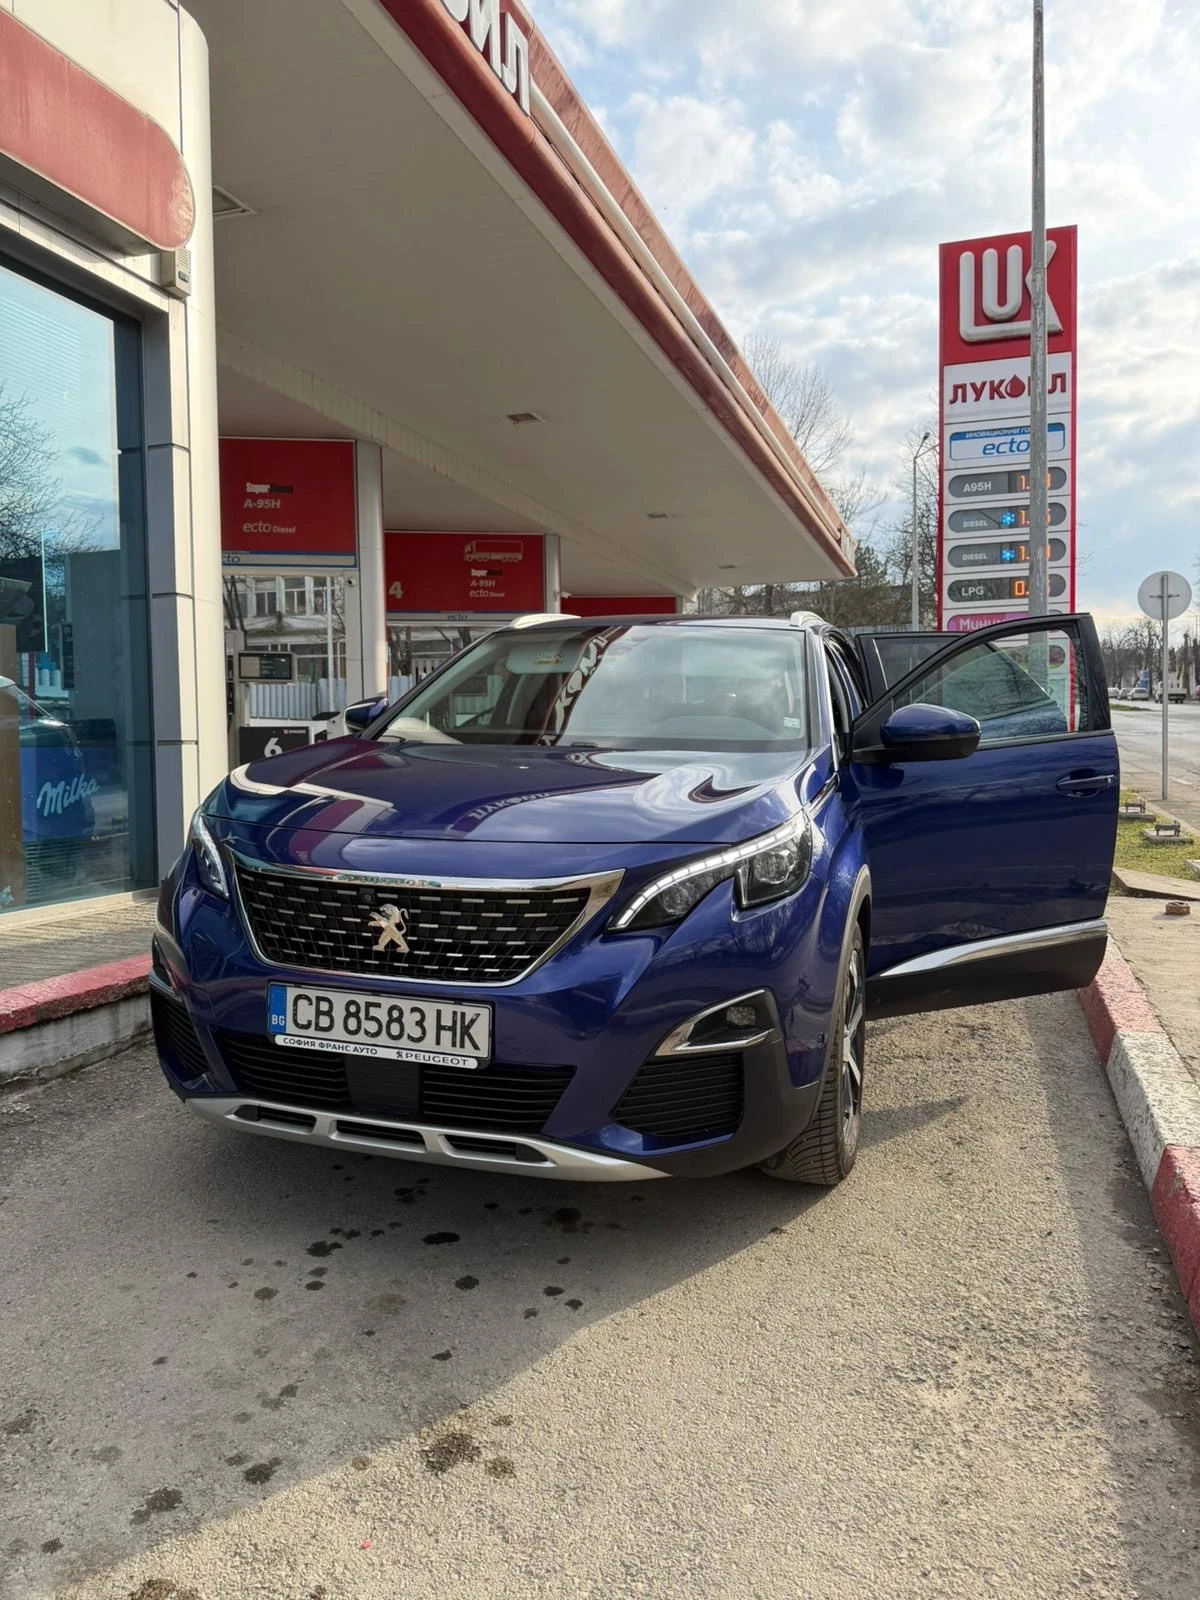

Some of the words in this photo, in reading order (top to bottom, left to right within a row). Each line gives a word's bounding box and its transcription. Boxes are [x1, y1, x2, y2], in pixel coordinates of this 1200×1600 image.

[982, 437, 1030, 456] ecto
[963, 481, 992, 493] A95H
[243, 498, 281, 509] A-95H
[242, 520, 271, 533] ecto
[388, 581, 404, 599] 4
[962, 586, 985, 597] LPG
[263, 737, 283, 759] 6
[36, 772, 101, 817] Milka
[271, 1014, 286, 1026] BG
[292, 993, 335, 1033] CB
[342, 999, 427, 1044] 8583
[435, 1008, 481, 1051] HK
[283, 1037, 317, 1048] СОФИЯ
[318, 1041, 351, 1053] ФРАНС
[352, 1046, 378, 1056] АУТО
[405, 1052, 469, 1067] PEUGEOT
